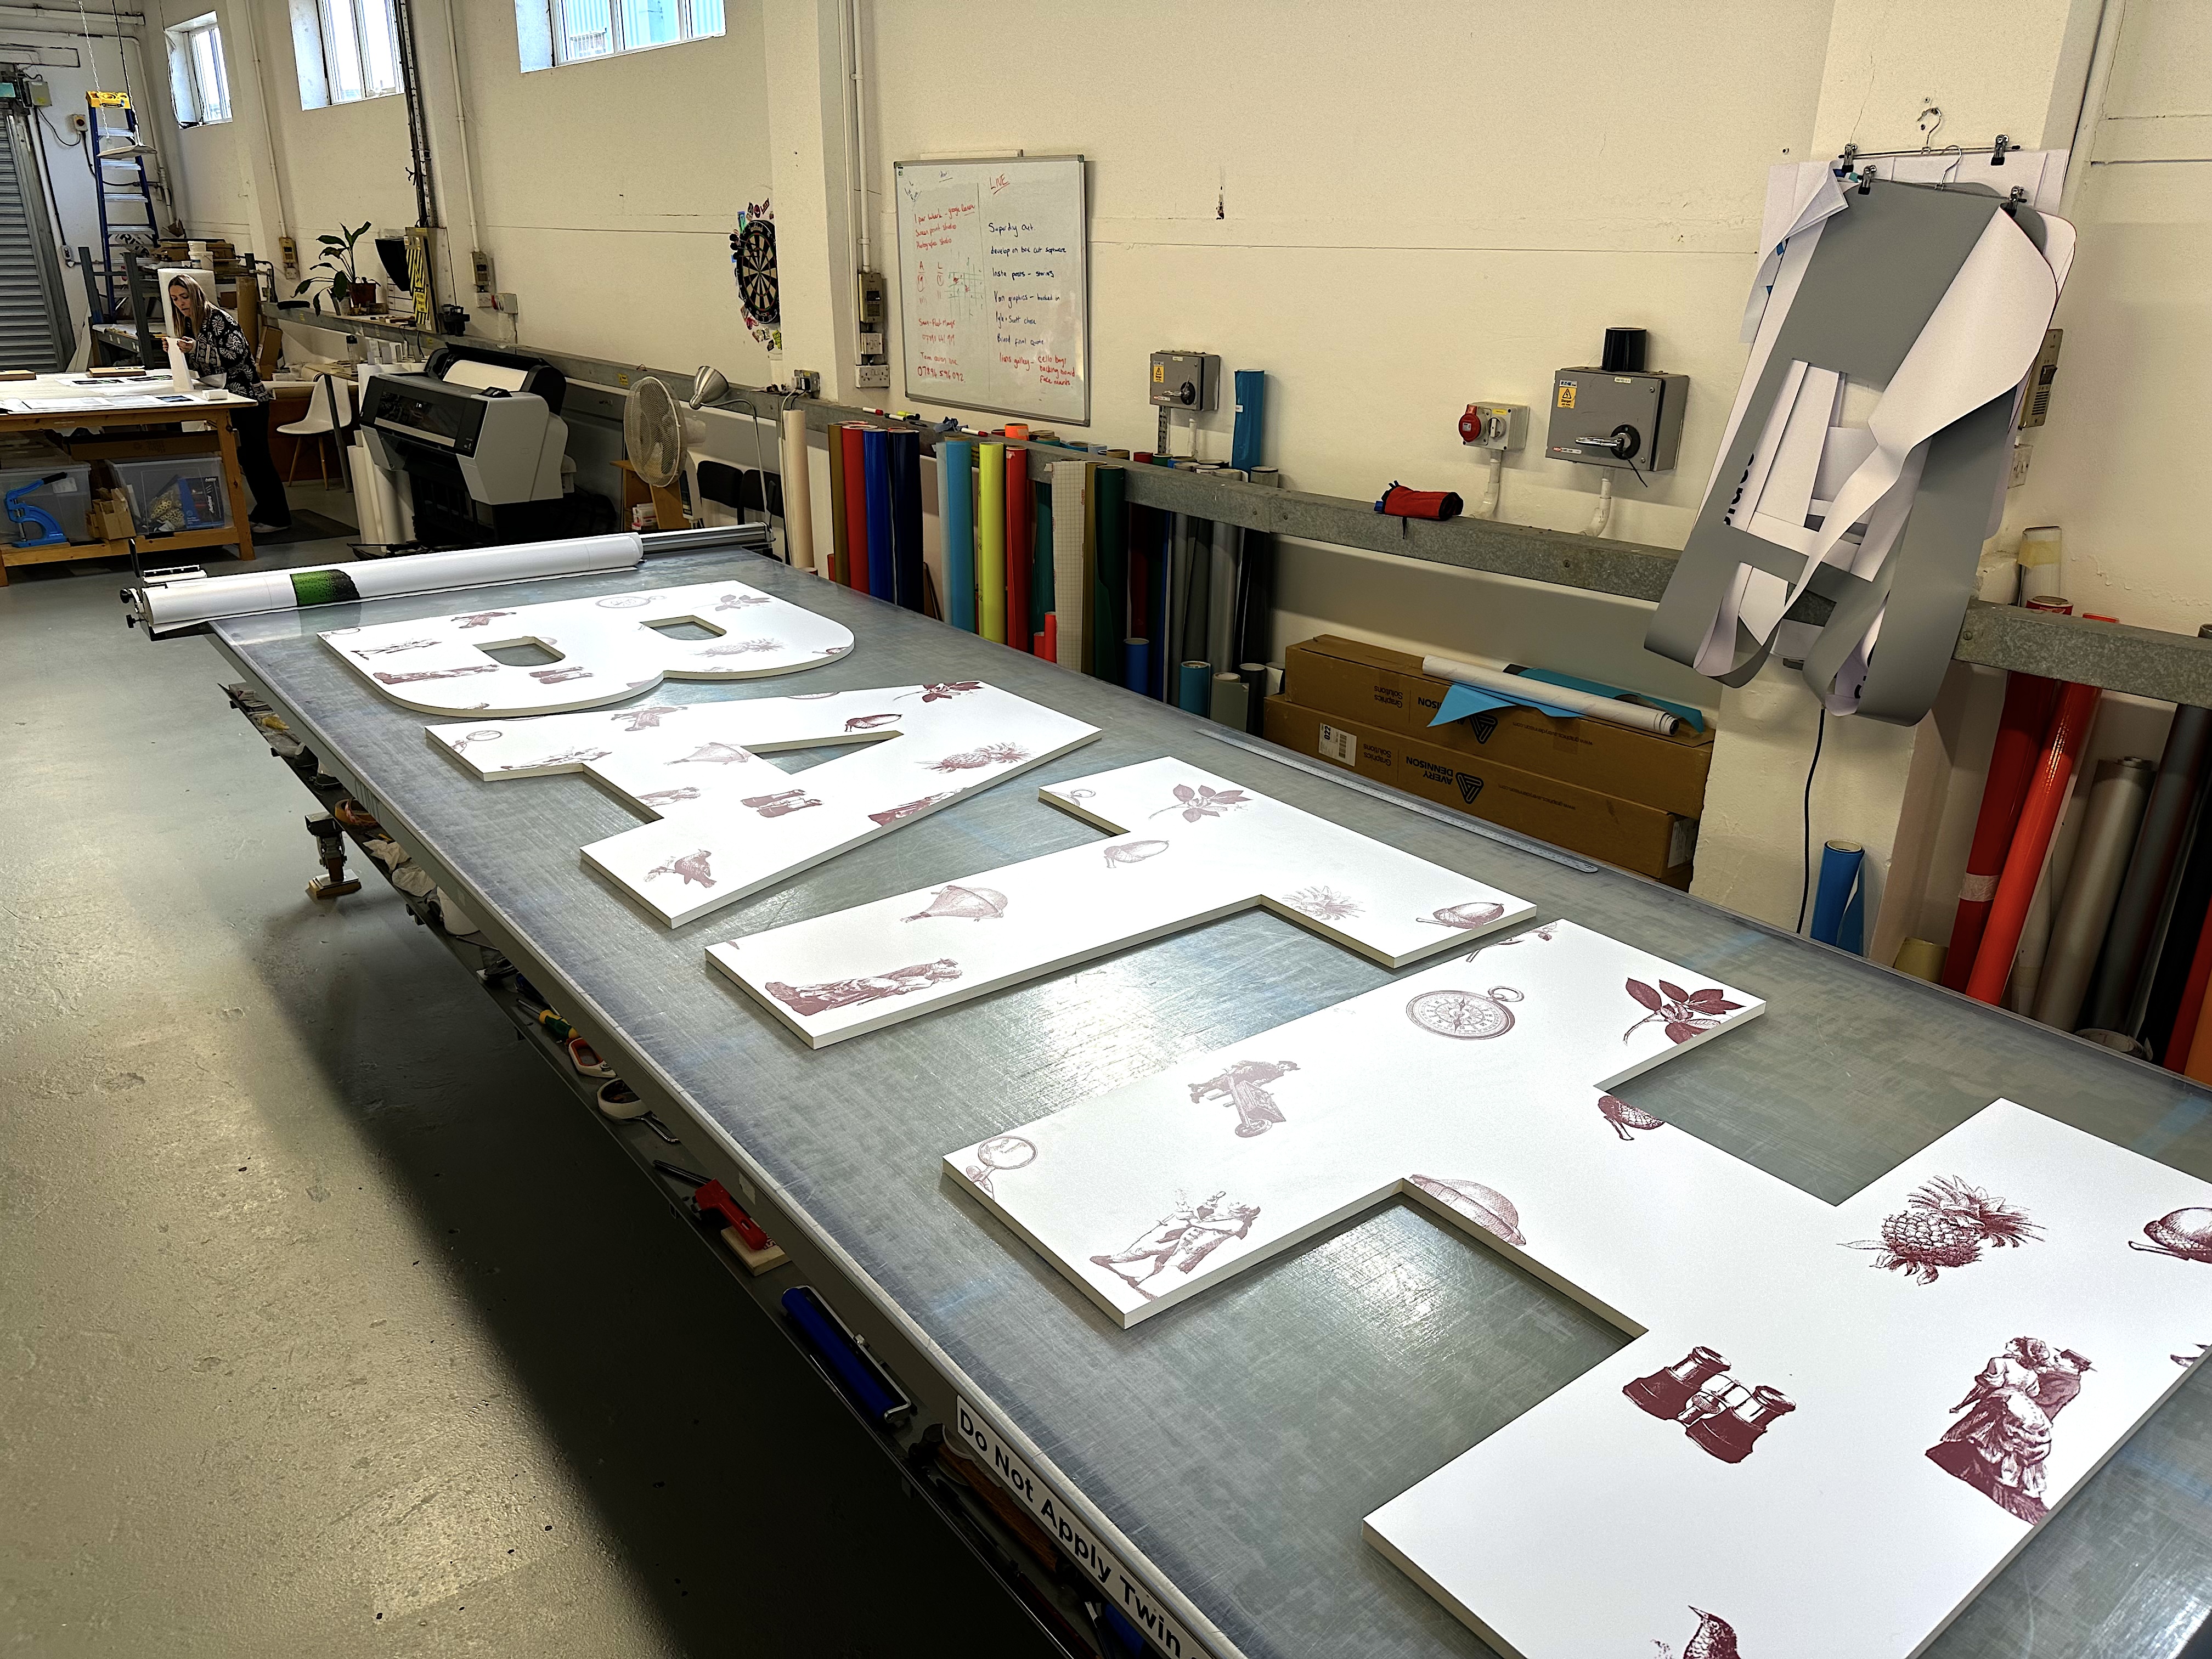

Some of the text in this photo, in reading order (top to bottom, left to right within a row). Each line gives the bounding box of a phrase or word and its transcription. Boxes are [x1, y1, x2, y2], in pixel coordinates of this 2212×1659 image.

[990, 173, 1009, 189] LIVE
[991, 246, 1010, 257] develop
[992, 268, 1007, 276] Insta
[1012, 271, 1025, 280] posts
[1008, 295, 1028, 308] graphics
[1374, 686, 1403, 699] Solutions
[1374, 694, 1403, 708] Graphics
[1363, 743, 1391, 758] Solutions
[1364, 752, 1391, 766] Graphics
[1406, 757, 1453, 777] DENNISON
[1423, 770, 1453, 785] AVERY
[961, 1407, 1181, 1657] Do Not Apply Twin
